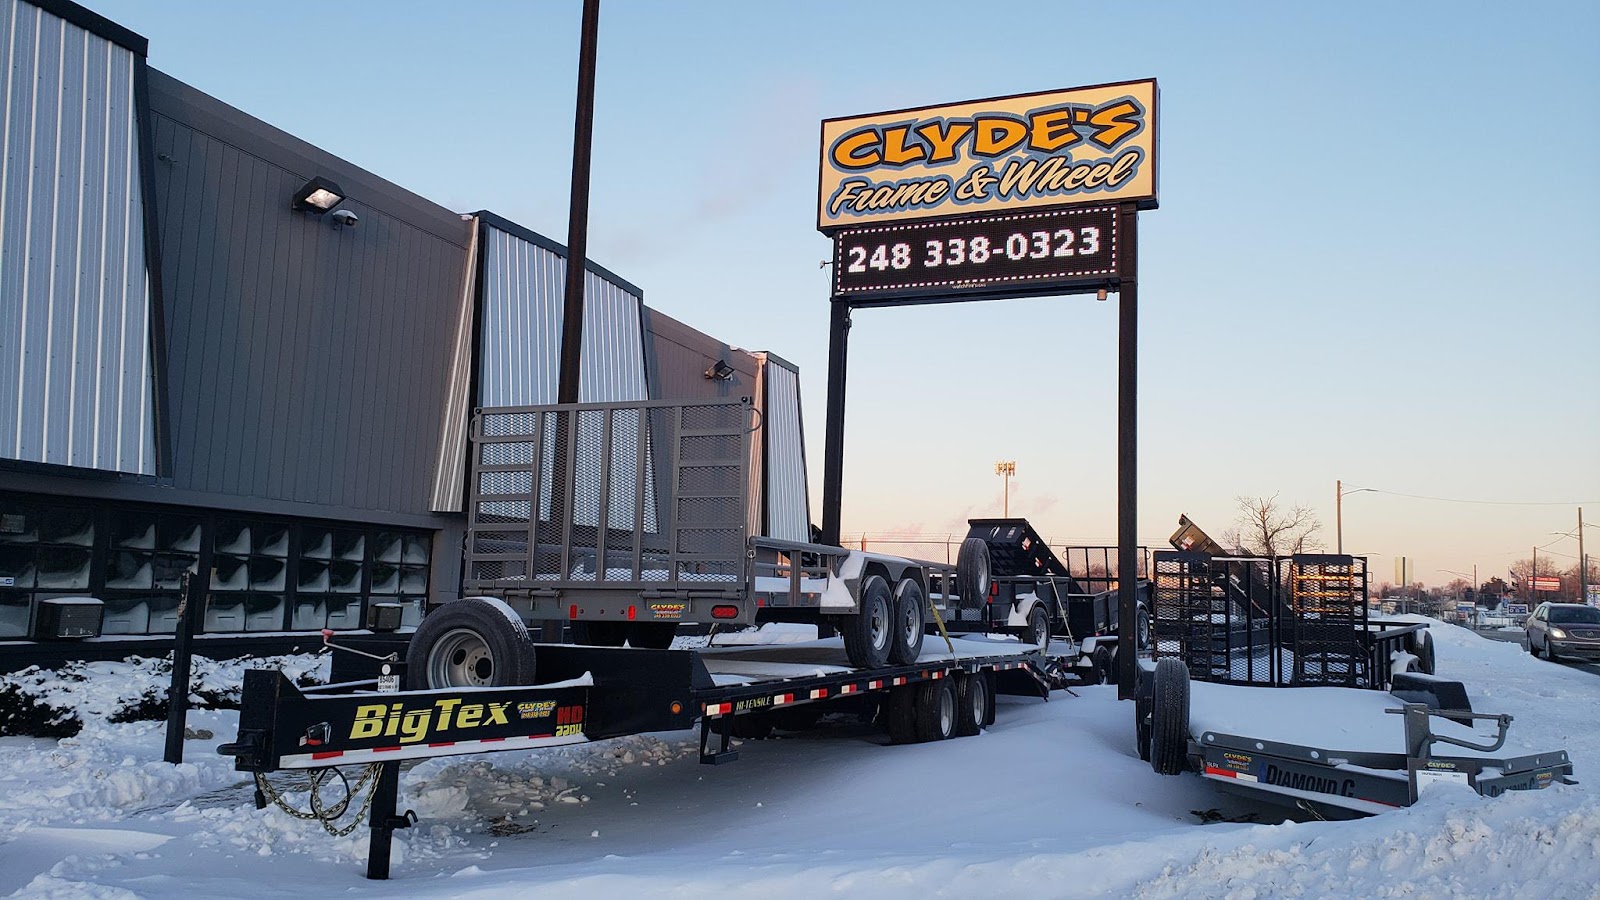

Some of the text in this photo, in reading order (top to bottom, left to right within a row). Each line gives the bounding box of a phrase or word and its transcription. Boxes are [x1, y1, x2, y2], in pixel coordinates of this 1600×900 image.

[831, 98, 1143, 168] CLYDE'S
[831, 151, 1139, 213] Frame & Wheel
[848, 226, 1100, 273] 248 338-0323
[517, 701, 556, 710] CLYDE'S
[557, 705, 583, 725] HD
[1266, 764, 1338, 794] DIAMOND
